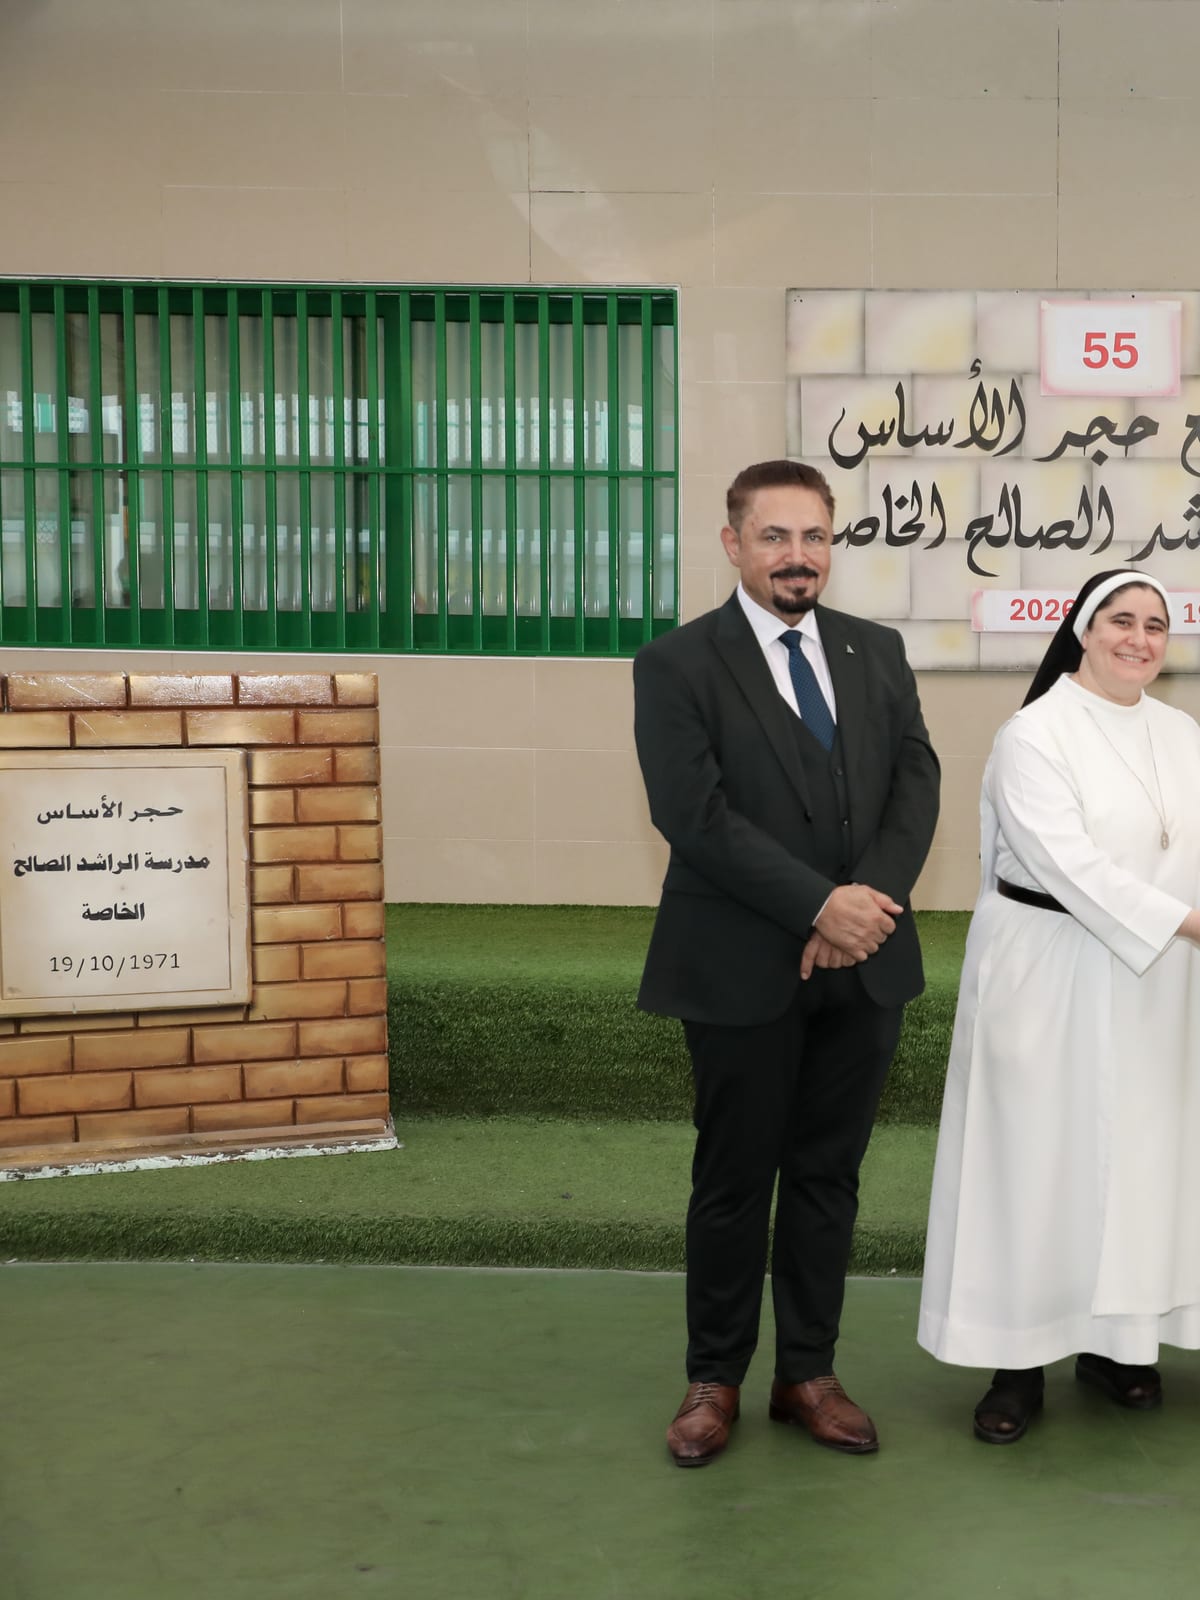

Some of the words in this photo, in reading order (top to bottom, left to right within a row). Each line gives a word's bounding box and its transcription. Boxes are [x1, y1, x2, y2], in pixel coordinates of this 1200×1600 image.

[1083, 332, 1139, 369] 55
[828, 358, 1026, 470] الأساس
[1032, 415, 1160, 466] حجر
[831, 480, 947, 550] الخاص
[964, 482, 1114, 577] الصالح
[37, 795, 123, 825] الأساس
[129, 806, 183, 822] حجر
[13, 854, 71, 877] الصالح
[76, 853, 139, 875] الراشد
[144, 852, 210, 874] مدرسة
[81, 902, 145, 921] الخاصة
[50, 953, 180, 978] 19/10/1971
